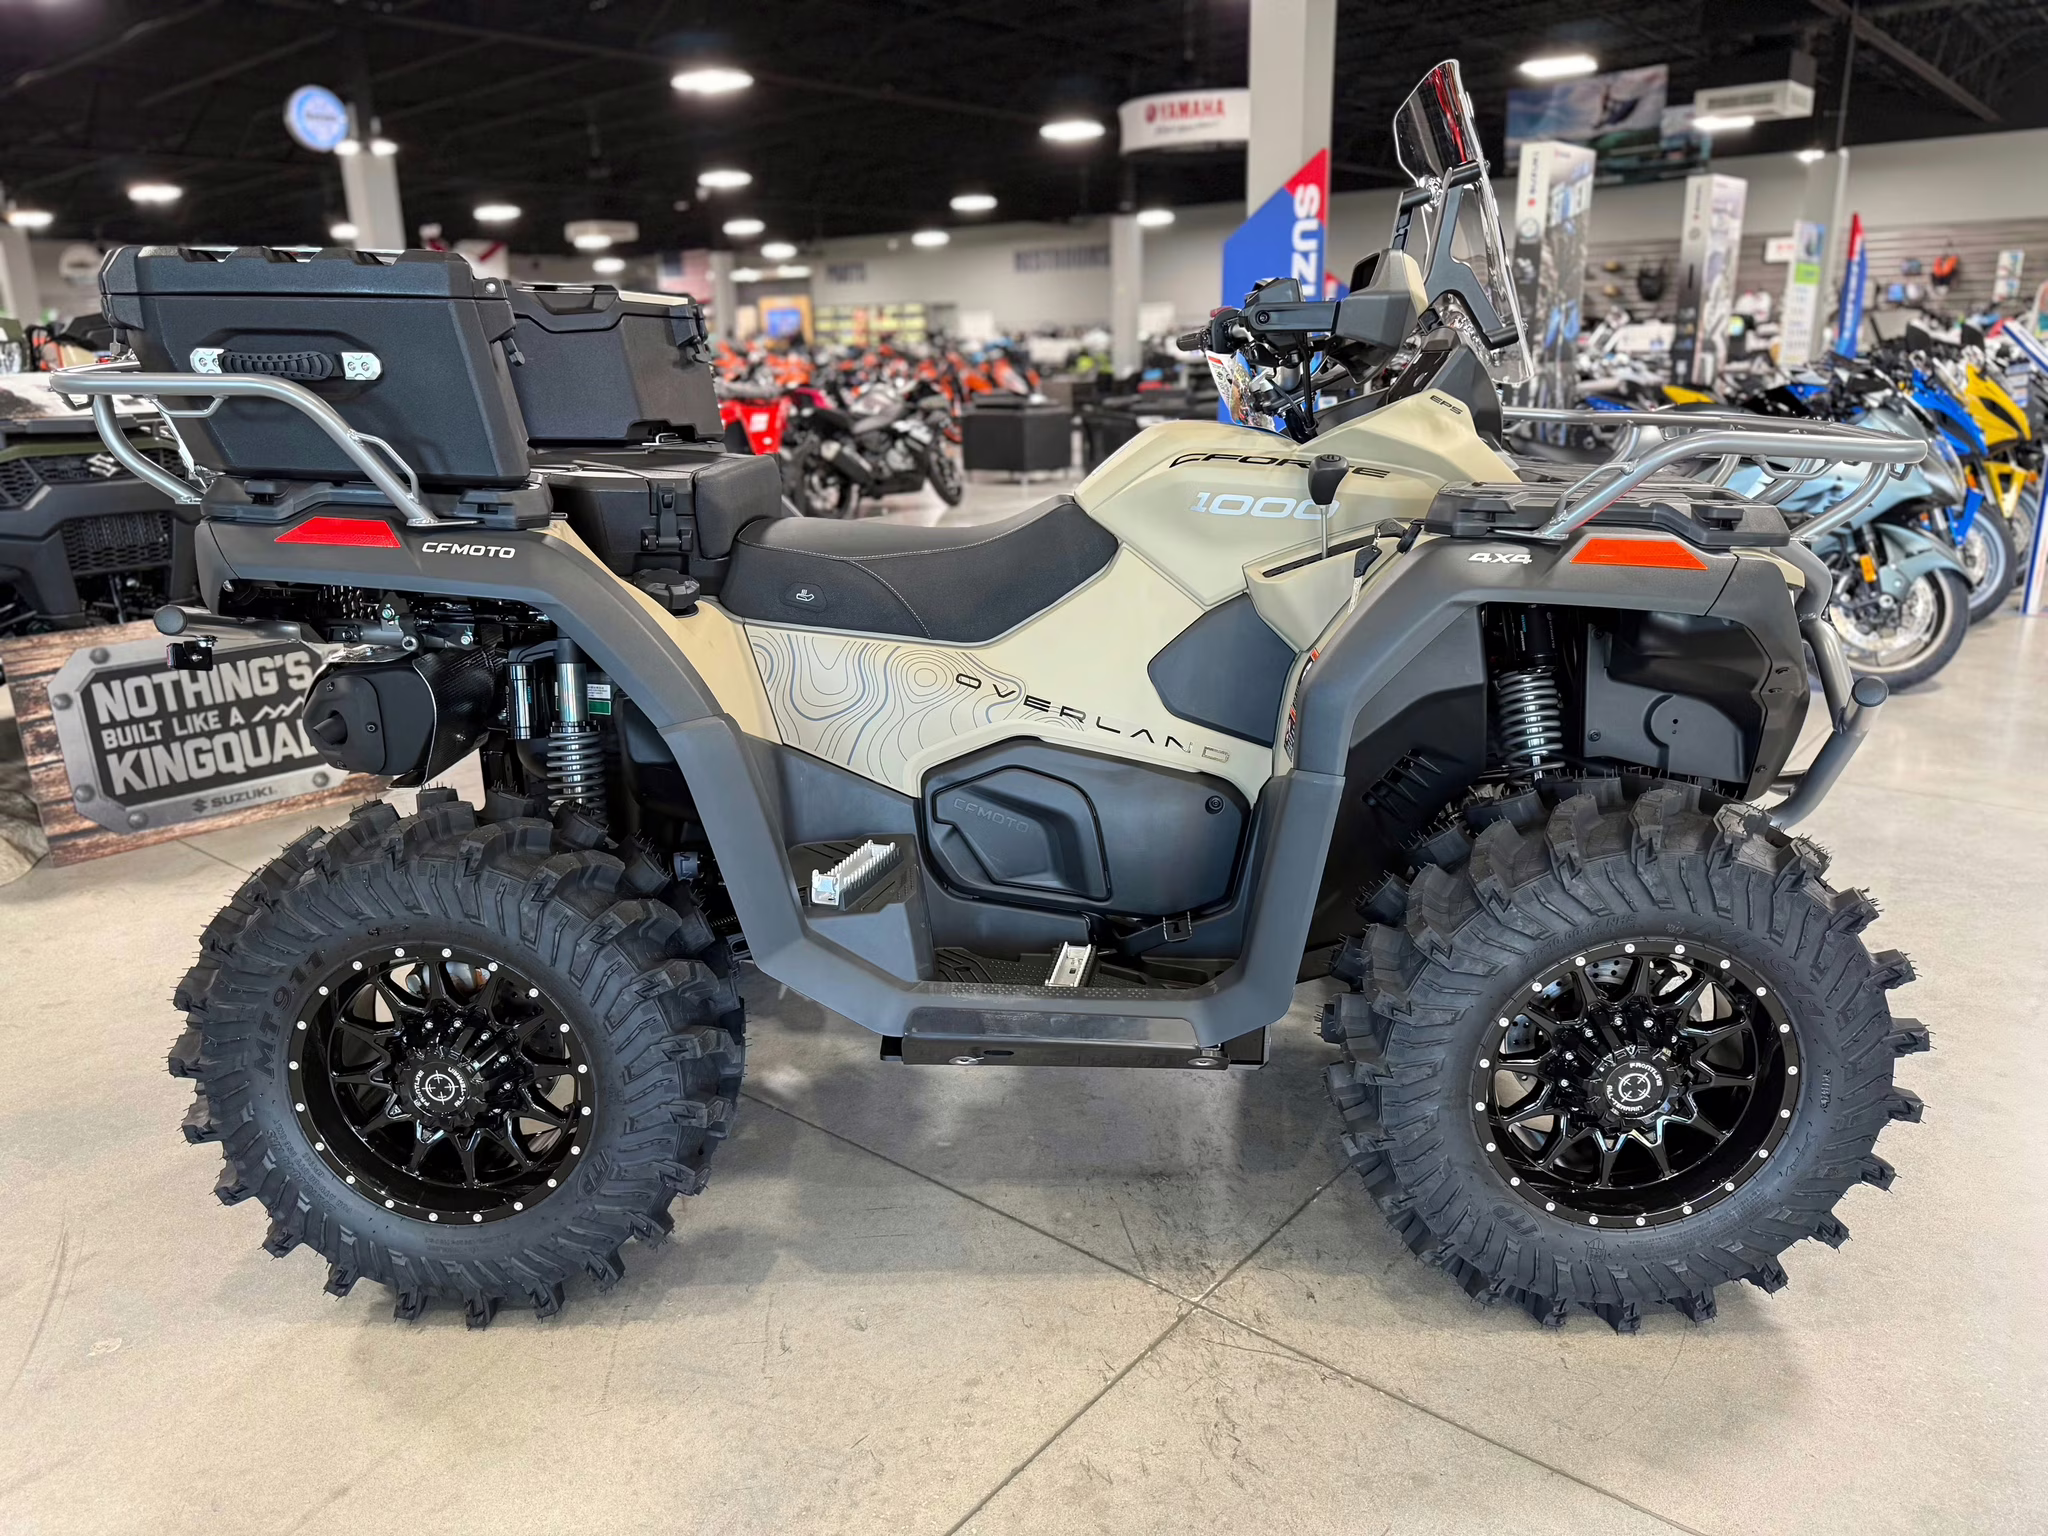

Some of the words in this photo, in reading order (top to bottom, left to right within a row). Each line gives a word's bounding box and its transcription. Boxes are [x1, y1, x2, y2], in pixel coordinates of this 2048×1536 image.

[1159, 98, 1226, 121] YAMAHA
[1430, 395, 1463, 415] EPS
[1169, 453, 1390, 479] CFORE
[1190, 492, 1340, 520] 1000
[422, 542, 516, 559] CFMOTO
[91, 650, 314, 725] NOTHING'S
[101, 721, 163, 750] BUILT
[172, 710, 222, 738] LIKE
[230, 706, 245, 727] A
[956, 673, 1230, 764] OVERLAND
[210, 786, 275, 808] SUZUKI
[953, 798, 1029, 833] CFMOTO
[1491, 1203, 1538, 1237] ITP
